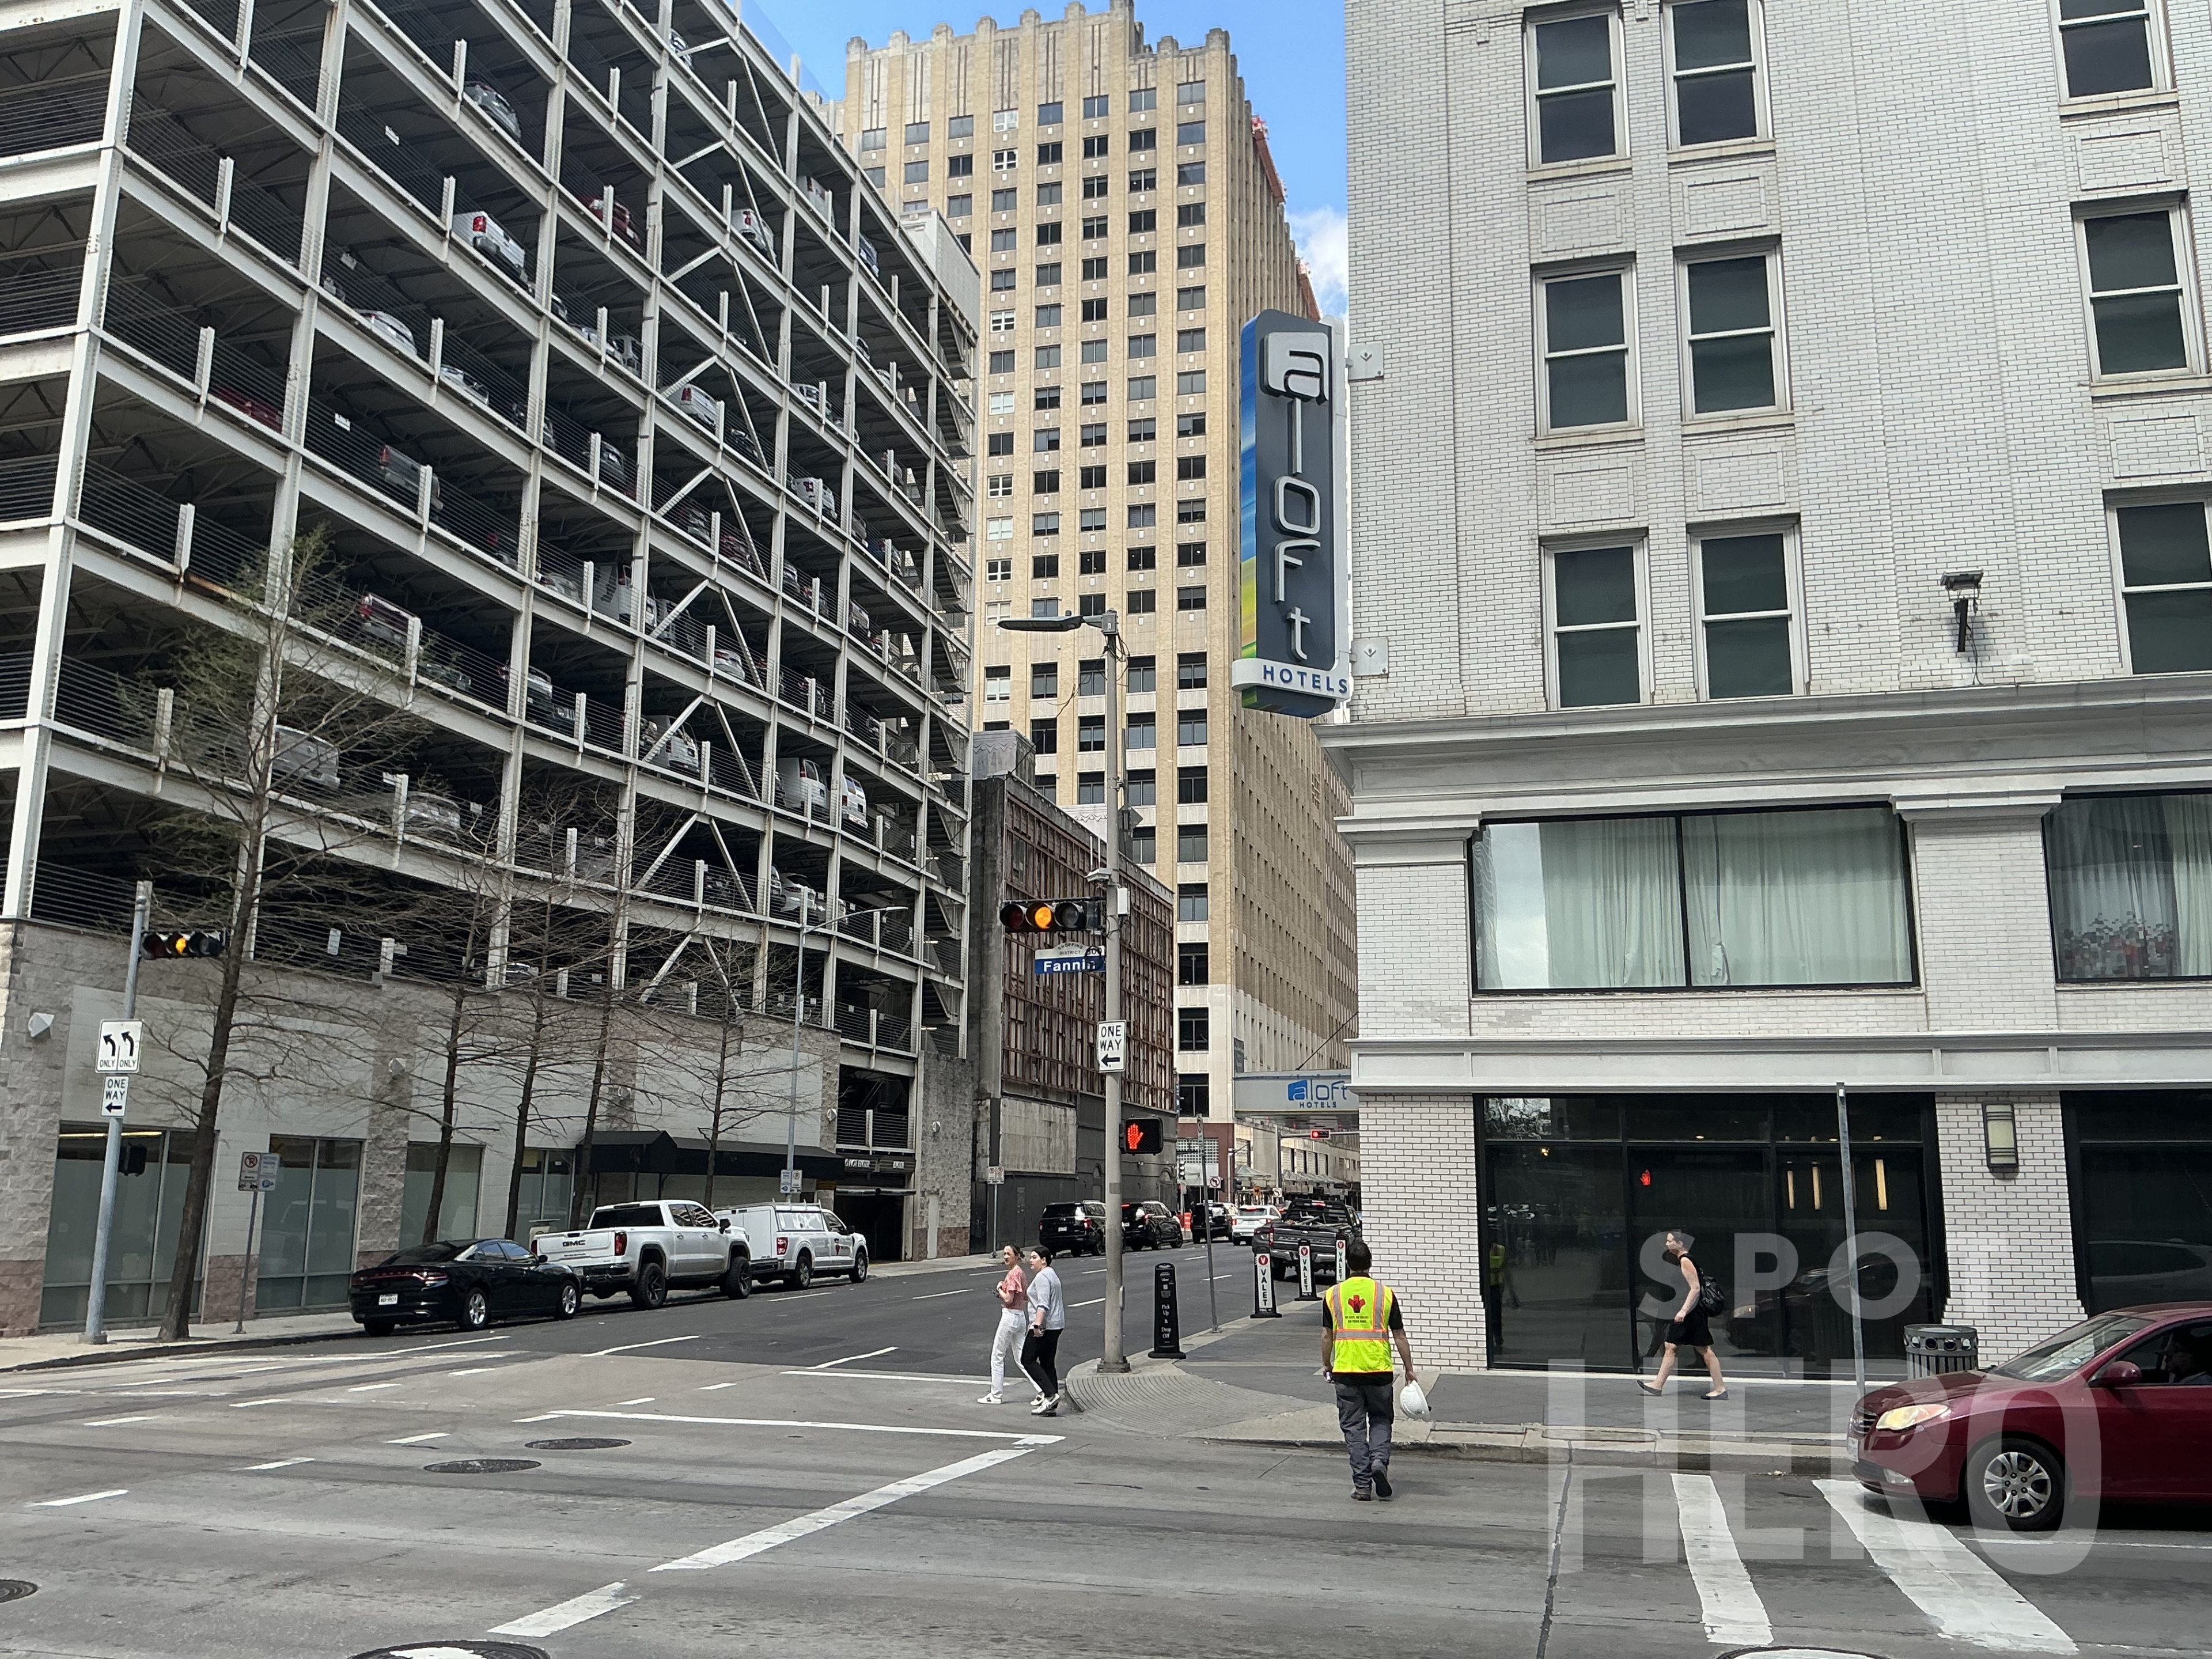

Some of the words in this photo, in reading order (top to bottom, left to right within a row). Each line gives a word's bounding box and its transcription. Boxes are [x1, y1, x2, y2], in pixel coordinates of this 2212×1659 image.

[1263, 664, 1347, 694] HOTELS
[1101, 1025, 1122, 1037] ONE
[1100, 1039, 1122, 1051] WAY
[100, 1059, 115, 1067] ONLY
[119, 1059, 137, 1067] ONLY
[107, 1079, 126, 1088] ONE
[105, 1090, 126, 1100] WAY
[1287, 1079, 1348, 1101] aloft
